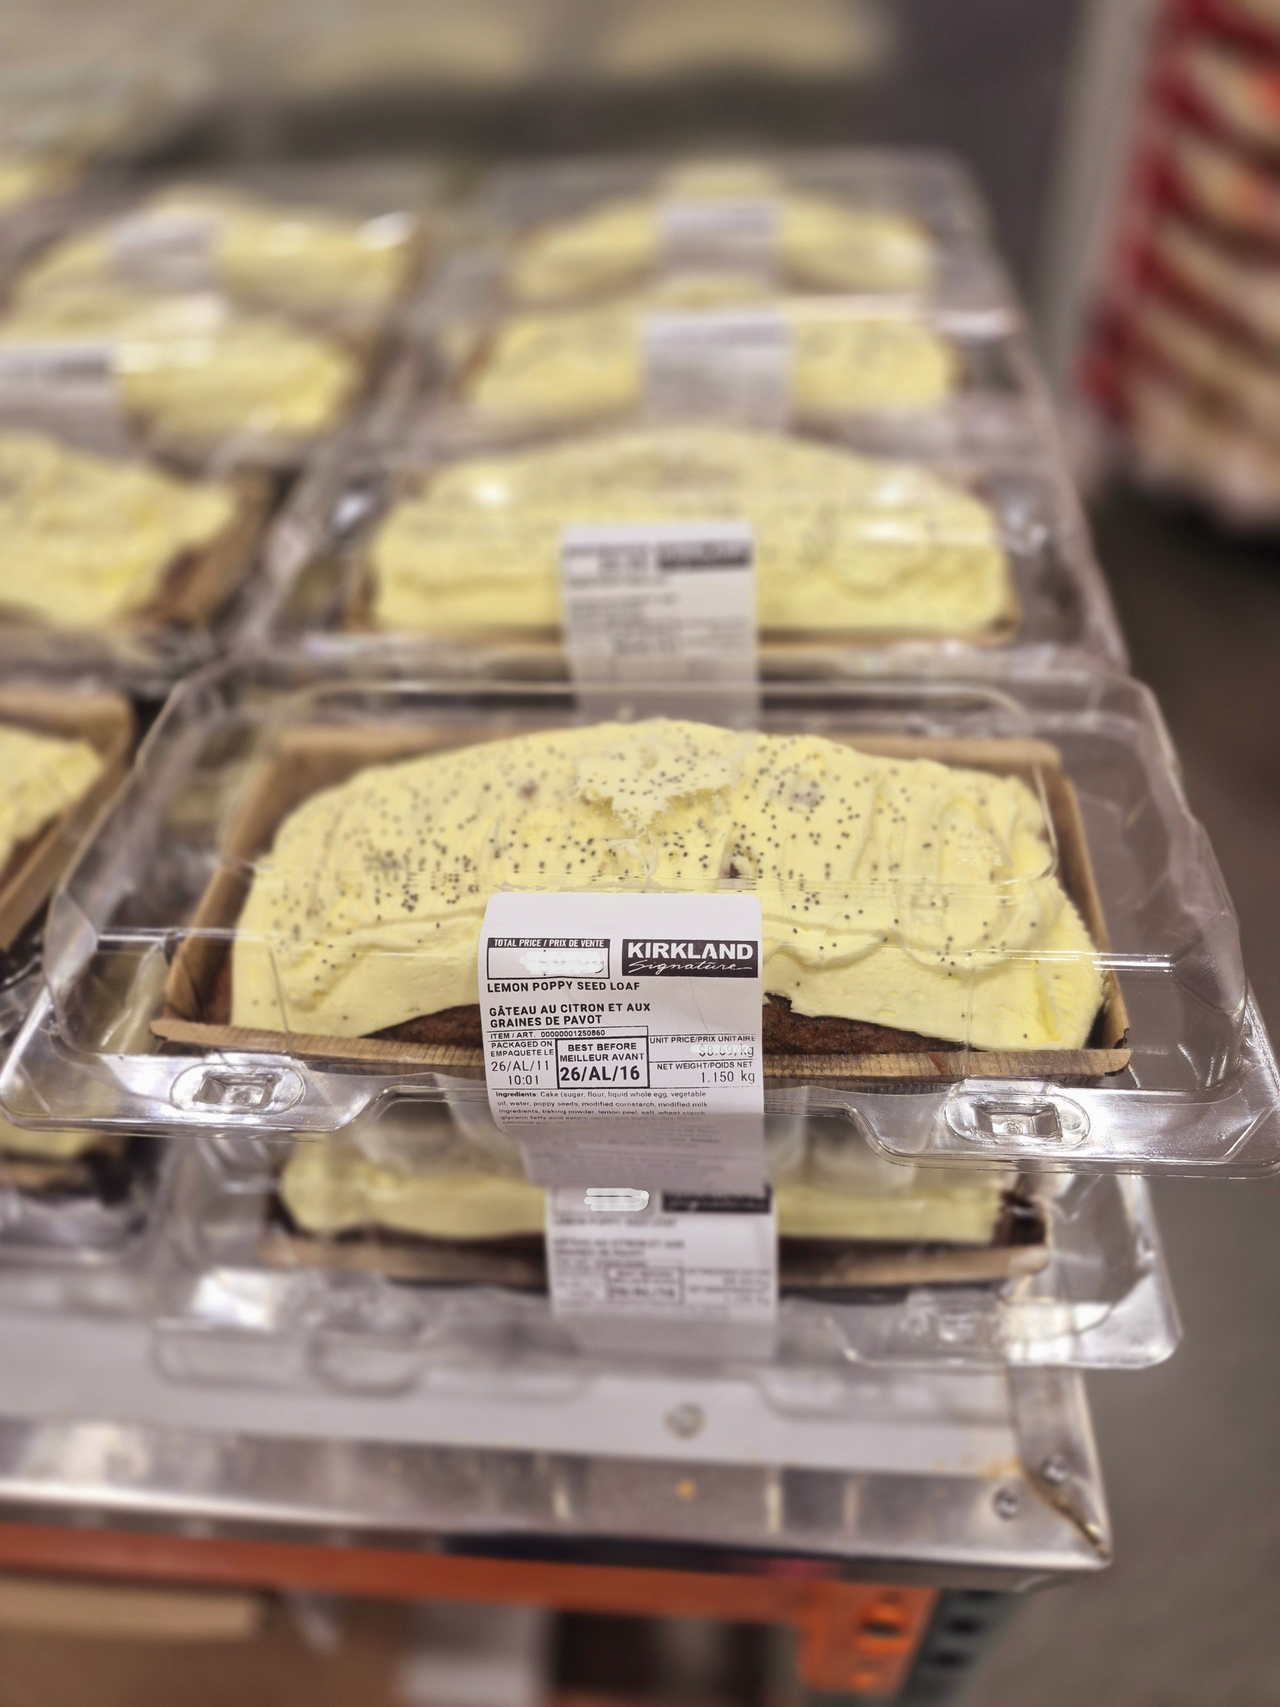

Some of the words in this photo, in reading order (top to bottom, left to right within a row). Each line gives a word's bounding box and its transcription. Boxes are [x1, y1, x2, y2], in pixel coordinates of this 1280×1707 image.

[494, 939, 517, 947] TOTAL
[519, 939, 541, 947] PRICE
[549, 939, 567, 947] PRIX
[628, 942, 753, 960] KIRKLAND
[628, 960, 752, 976] Signature
[487, 982, 528, 993] LEMON
[532, 980, 573, 992] POPPY
[577, 981, 606, 990] SEED
[610, 982, 640, 990] LOAF
[490, 1005, 536, 1016] GÂTEAU
[540, 1004, 556, 1014] AU
[560, 1003, 604, 1013] CITRON
[608, 1003, 622, 1012] ET
[626, 1003, 650, 1012] AUX
[490, 1017, 541, 1028] GRAINES
[546, 1016, 560, 1026] DE
[564, 1014, 602, 1024] PAVOT
[540, 1030, 606, 1038] 00000001250860
[490, 1049, 542, 1057] EMPAQUETE
[568, 1044, 594, 1052] BEST
[596, 1042, 637, 1051] BEFORE
[560, 1054, 609, 1062] MEILLEUR
[612, 1052, 644, 1060] AVANT
[491, 1060, 549, 1072] 26/AL/11
[560, 1065, 640, 1082] 26/AL/16
[701, 1070, 734, 1084] 1.150
[740, 1070, 755, 1084] kg
[508, 1075, 539, 1085] 10:01
